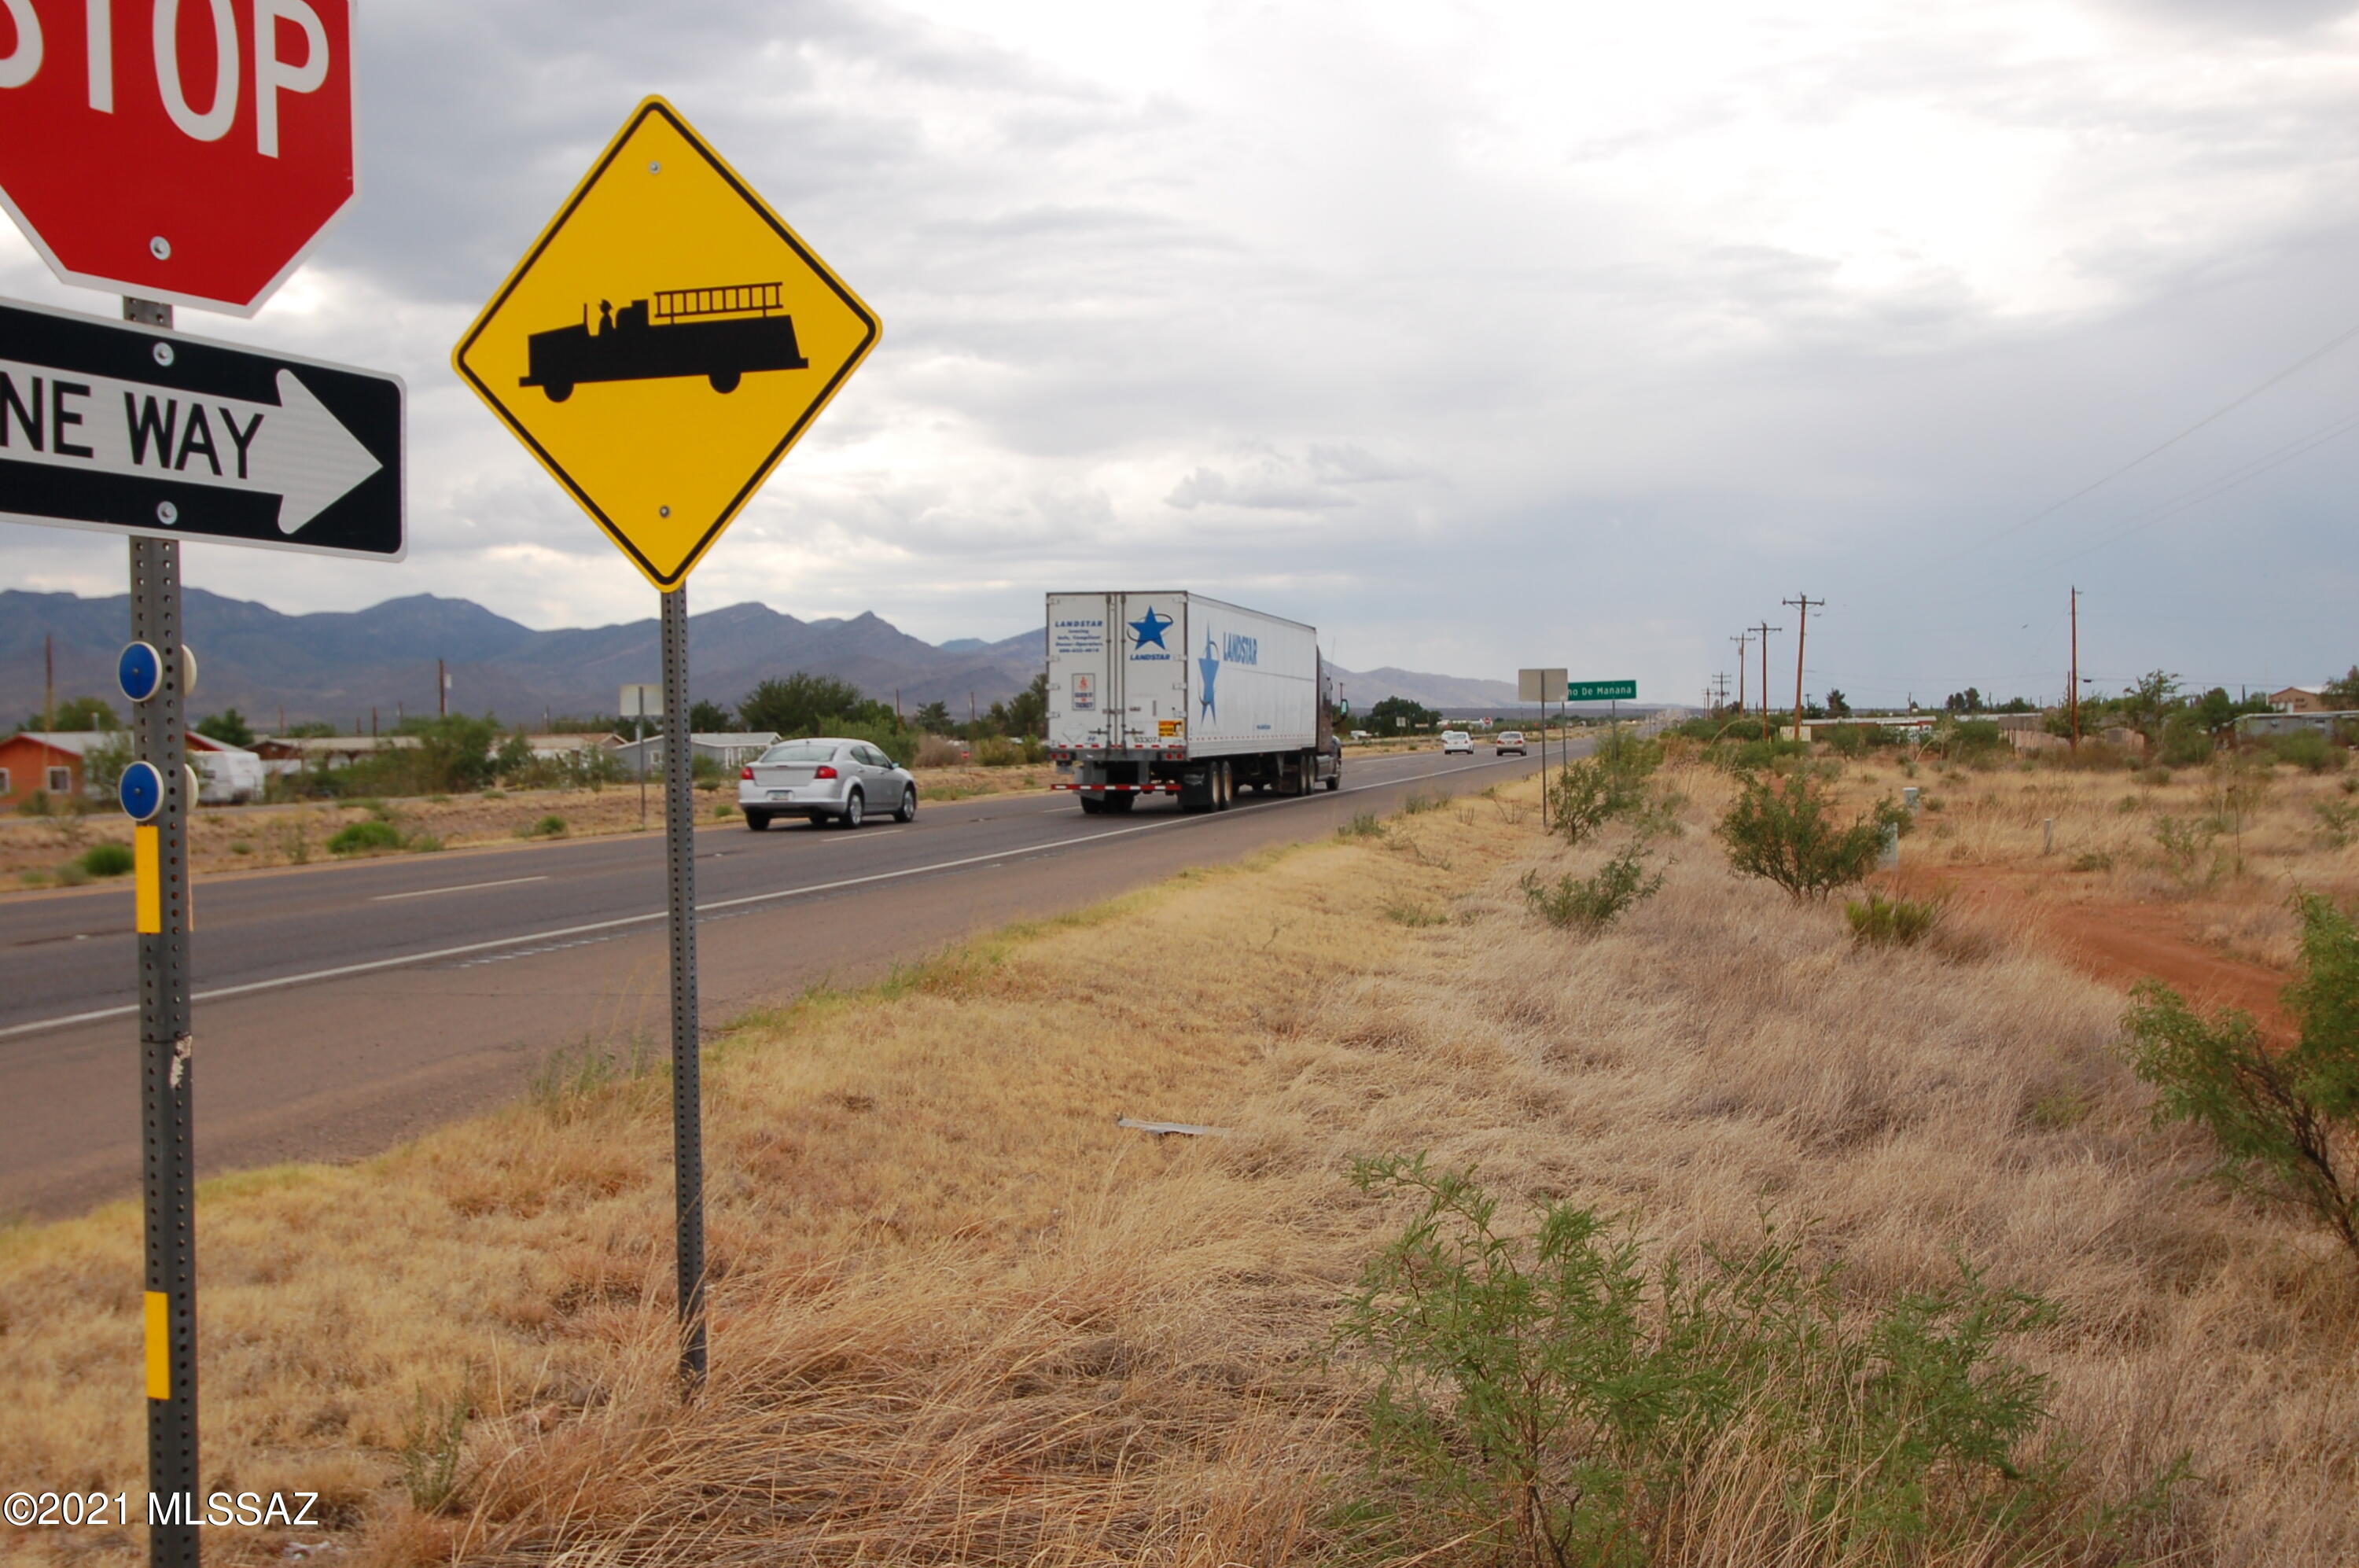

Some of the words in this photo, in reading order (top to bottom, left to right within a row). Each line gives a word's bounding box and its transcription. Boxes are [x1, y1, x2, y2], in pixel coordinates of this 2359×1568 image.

[0, 0, 329, 159] TOP
[0, 370, 94, 459] NE
[123, 391, 264, 480] WAY
[1223, 631, 1257, 666] LANDSTAR
[1581, 686, 1593, 696] De
[1596, 686, 1632, 695] Manana
